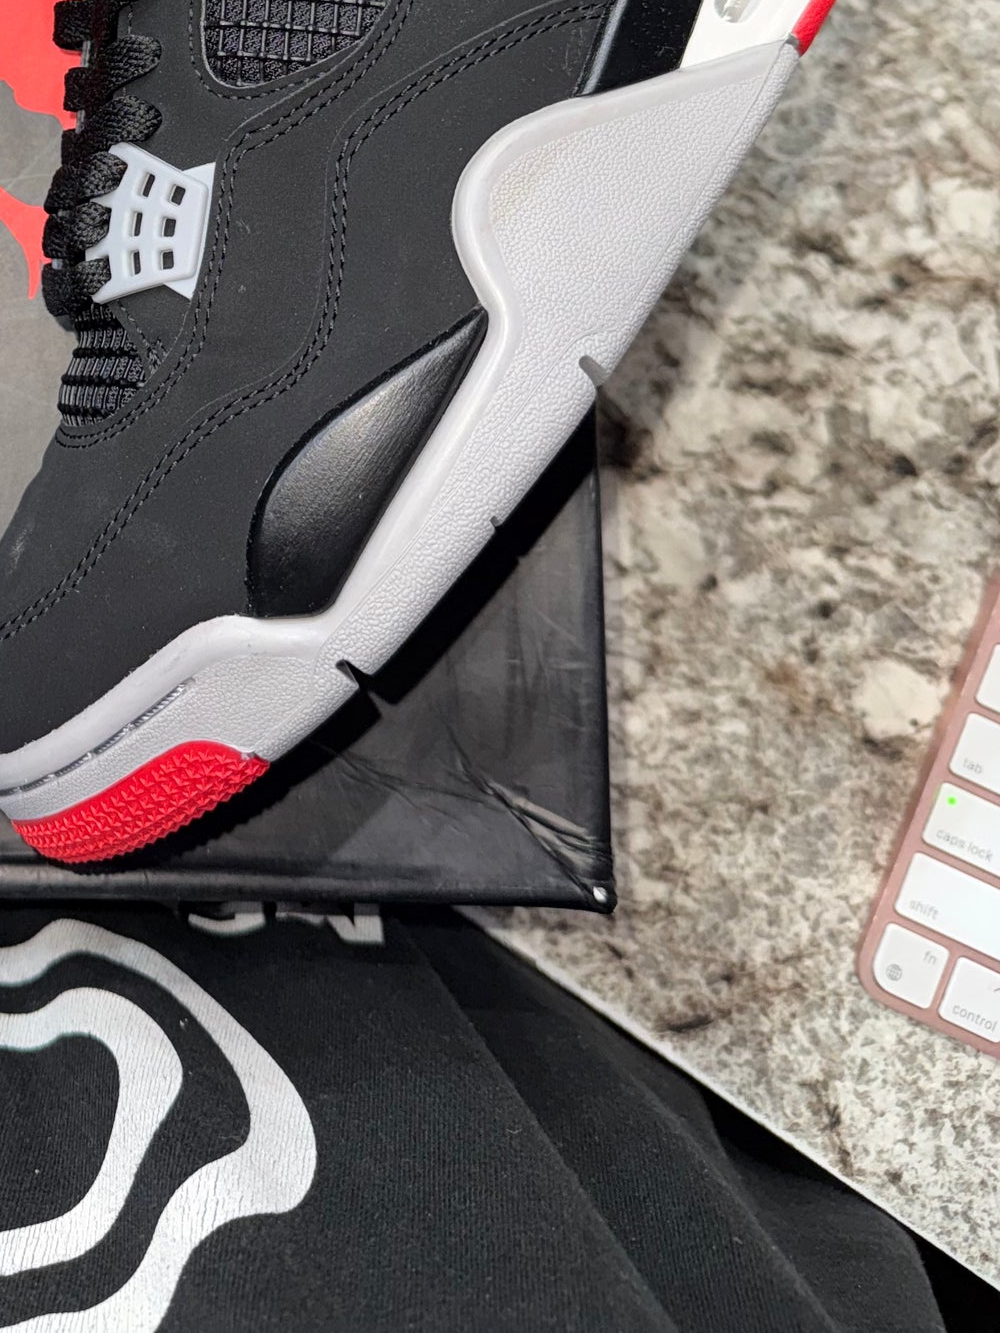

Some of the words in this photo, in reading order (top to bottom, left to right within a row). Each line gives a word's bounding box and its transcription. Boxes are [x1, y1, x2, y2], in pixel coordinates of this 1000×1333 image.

[962, 757, 983, 775] tab
[936, 828, 965, 849] caps
[967, 841, 994, 863] lock
[909, 899, 939, 920] shift
[923, 950, 938, 965] fn
[951, 1004, 998, 1033] control
